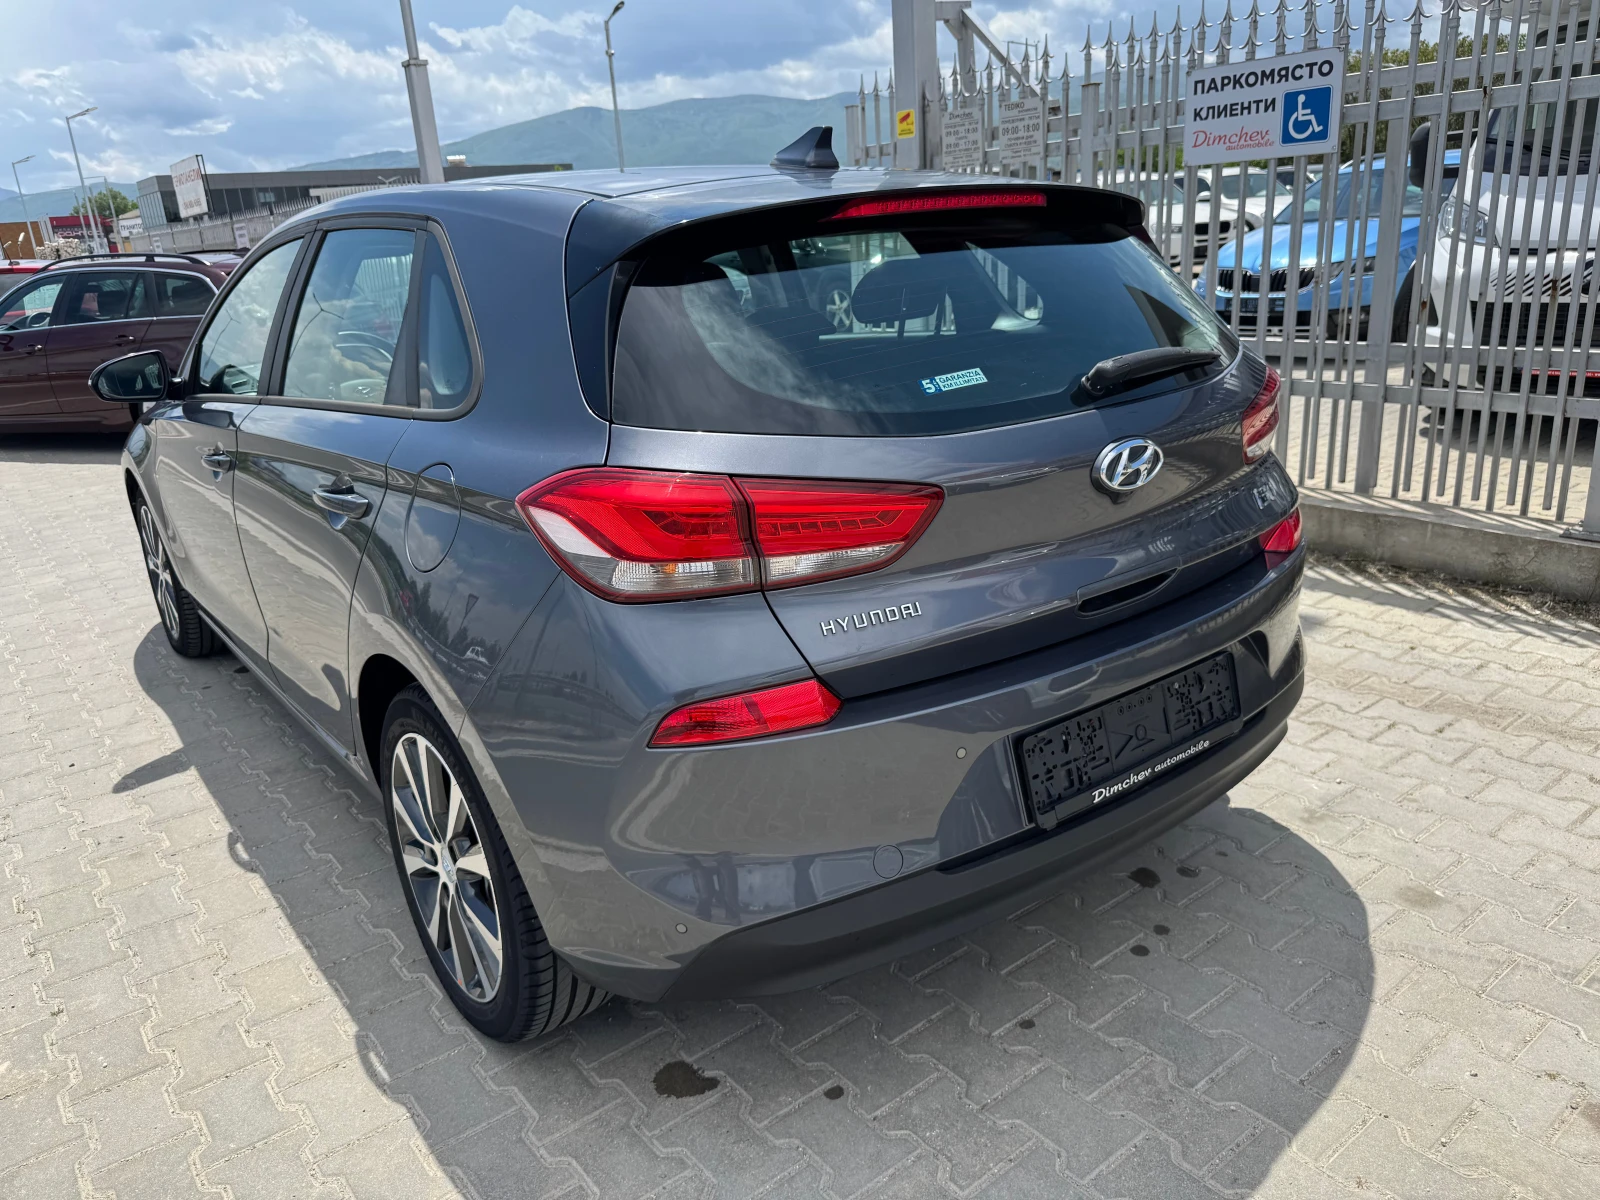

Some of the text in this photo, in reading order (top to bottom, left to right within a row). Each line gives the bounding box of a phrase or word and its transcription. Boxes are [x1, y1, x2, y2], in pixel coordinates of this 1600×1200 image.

[1193, 59, 1334, 96] ПАРКОМЯСТО
[1193, 97, 1277, 122] КЛИЕНТИ
[1192, 126, 1270, 149] Dimchev
[1225, 138, 1275, 151] automobile
[922, 379, 936, 393] 5
[939, 370, 981, 384] GARANZIA
[820, 601, 922, 637] HYUNDAI
[1091, 738, 1210, 804] Dimchev automobile
